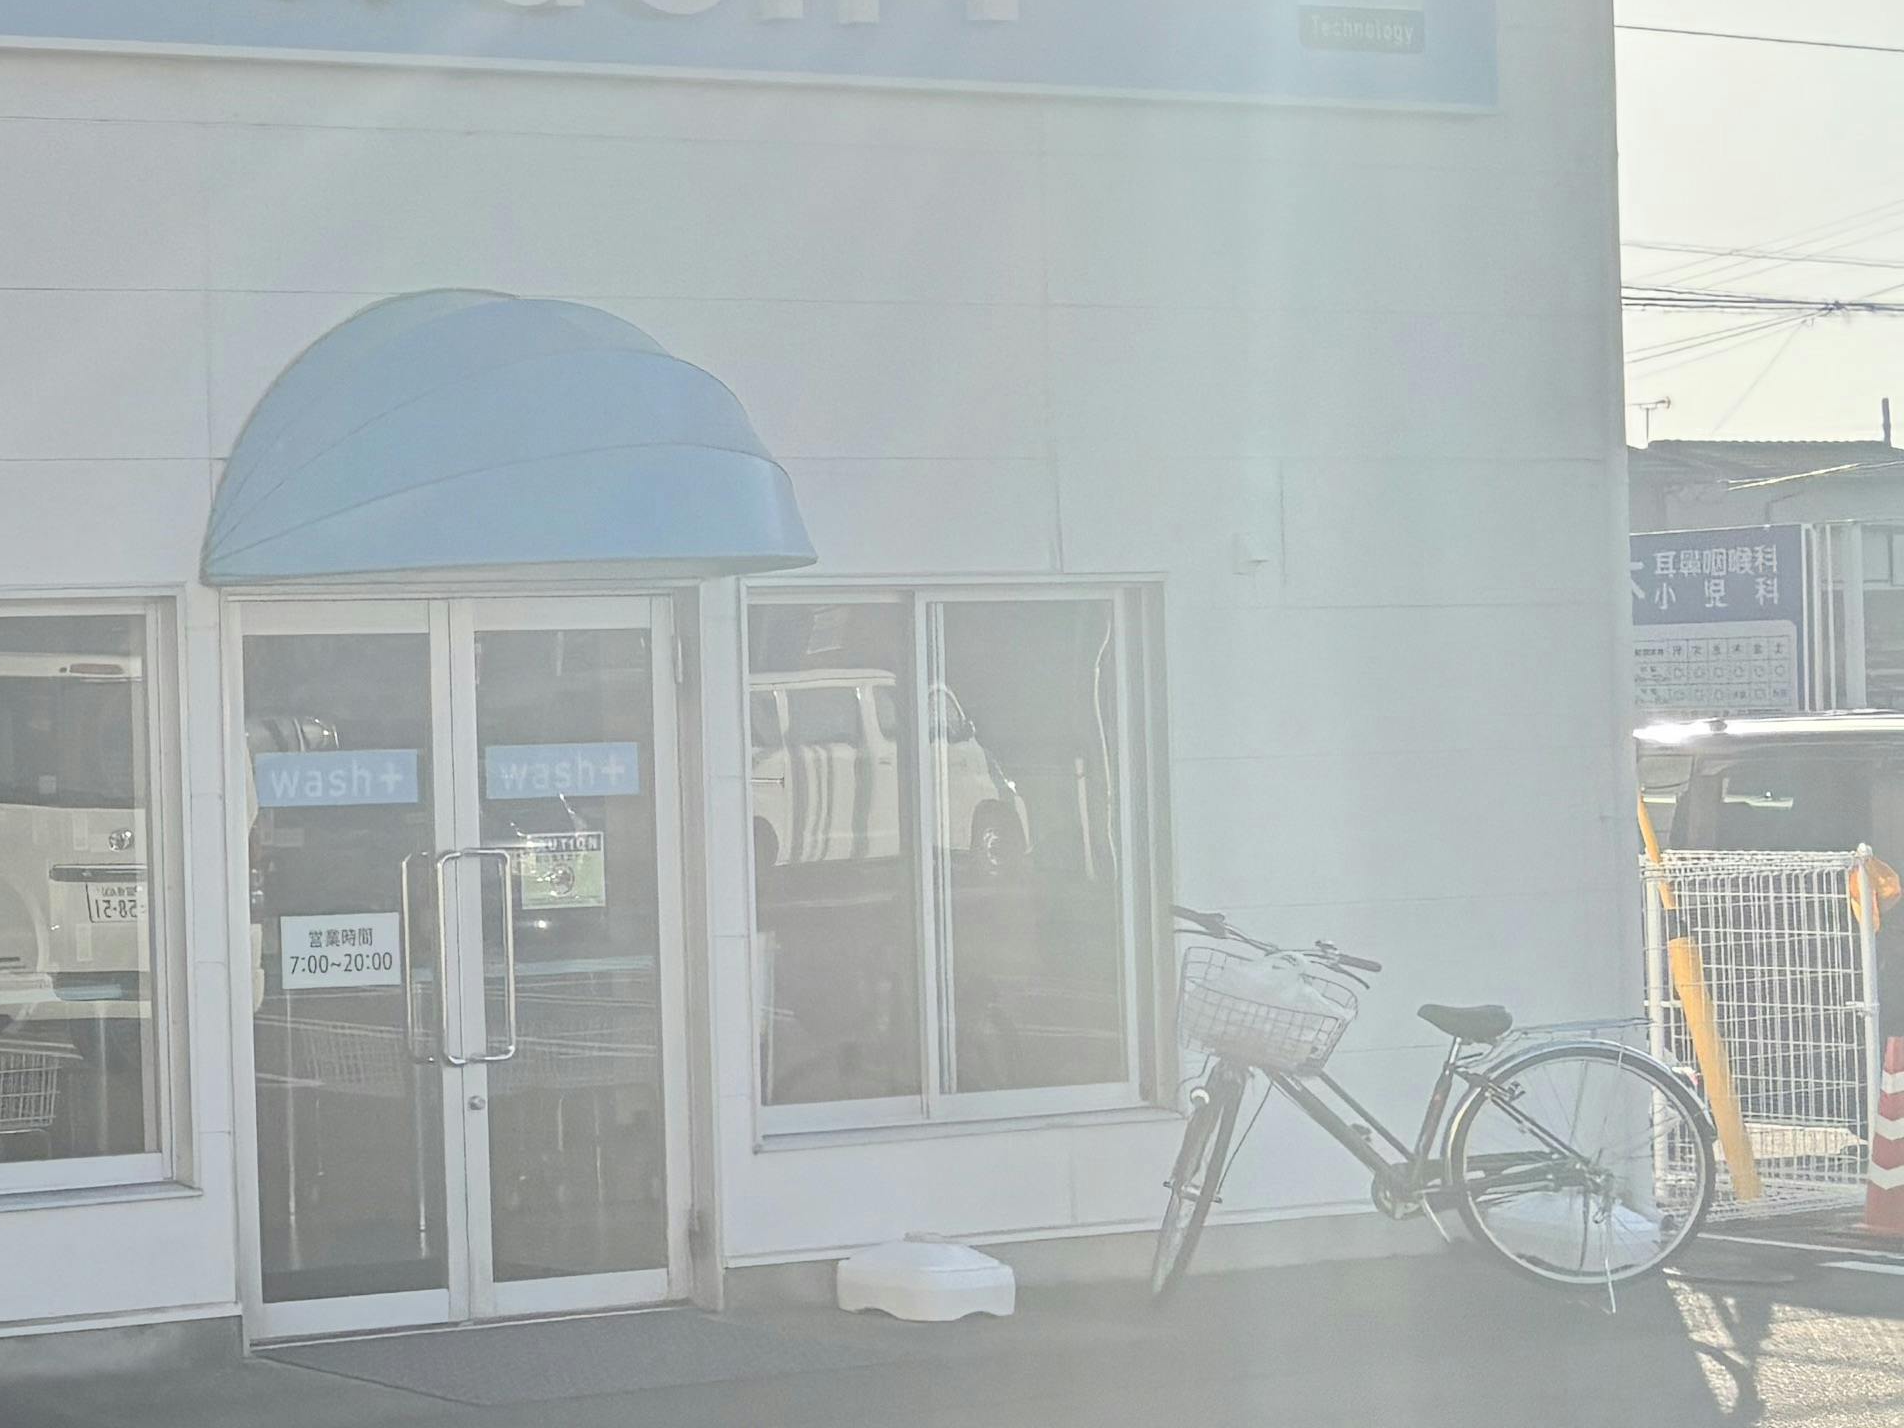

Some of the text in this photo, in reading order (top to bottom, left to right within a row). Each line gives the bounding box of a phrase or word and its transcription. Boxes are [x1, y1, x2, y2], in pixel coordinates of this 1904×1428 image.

[1310, 13, 1416, 46] Technology
[308, 928, 373, 948] 営業時間
